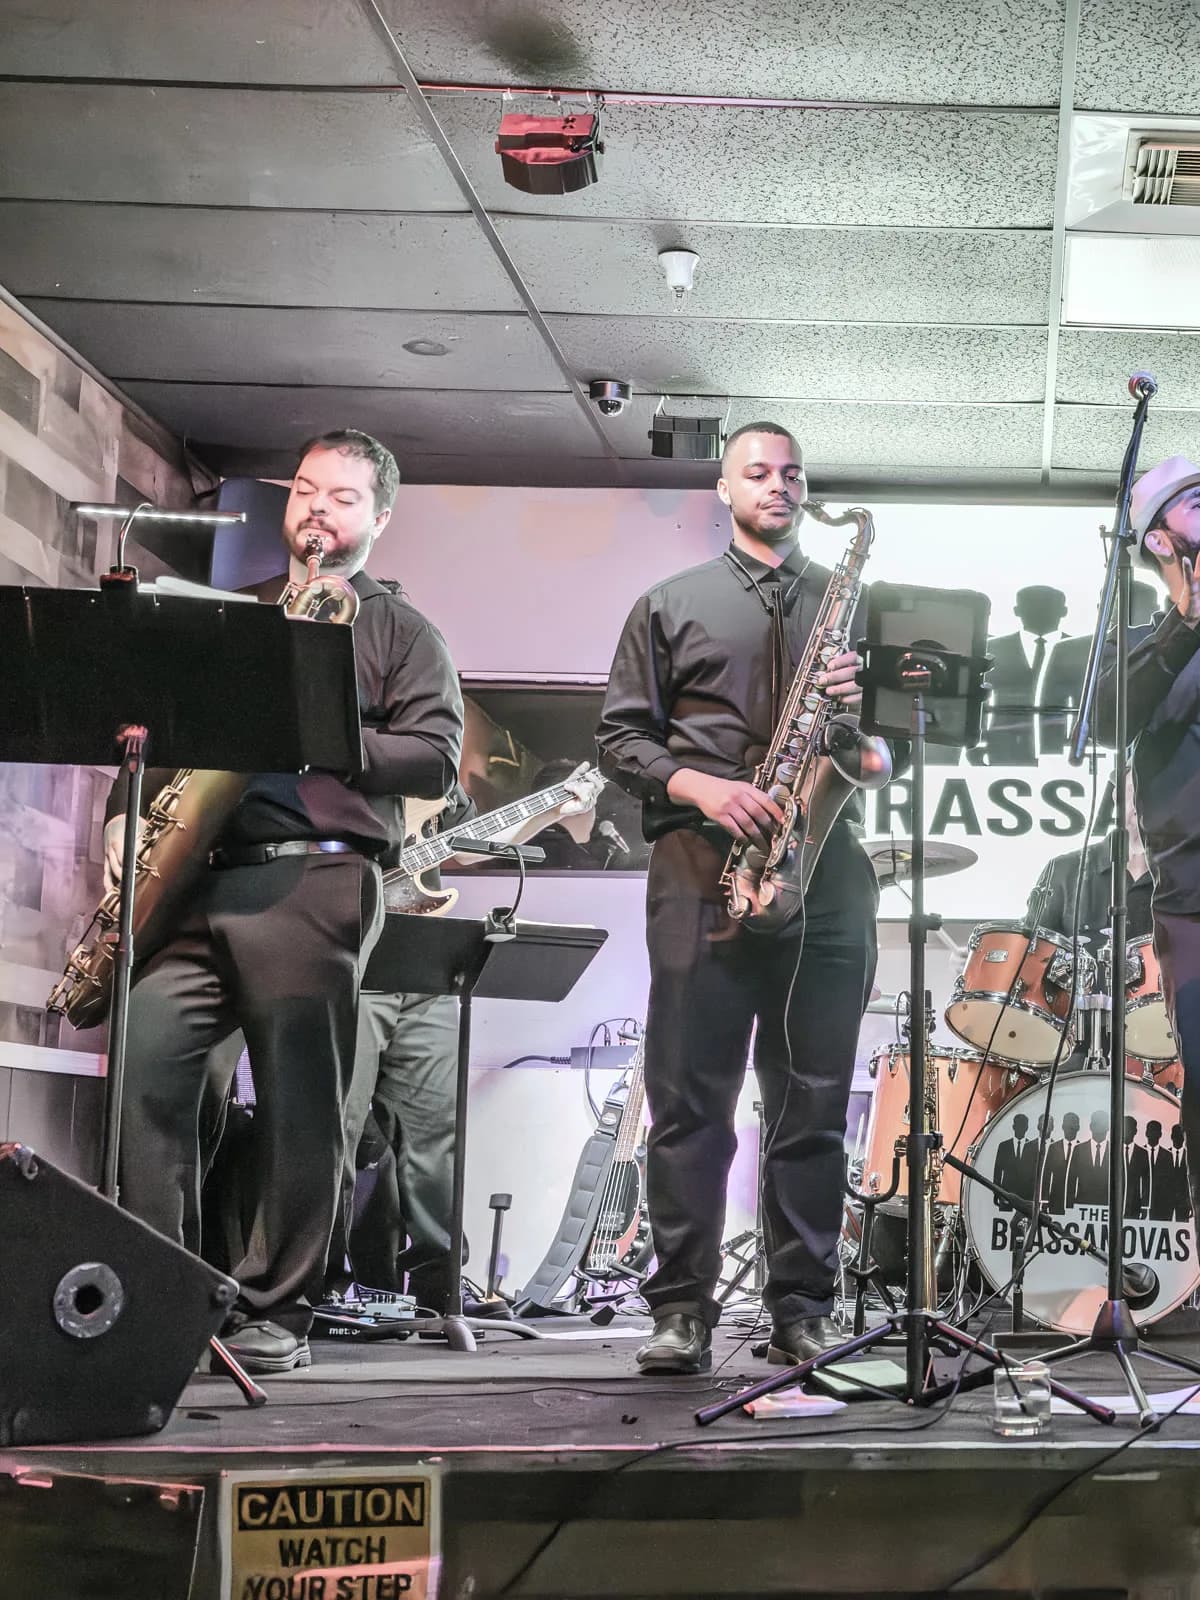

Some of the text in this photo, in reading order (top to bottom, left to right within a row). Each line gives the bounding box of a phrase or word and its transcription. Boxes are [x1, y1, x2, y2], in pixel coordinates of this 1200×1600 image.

[241, 1488, 422, 1526] CAUTION
[279, 1535, 386, 1568] WATCH
[243, 1573, 412, 1600] YOUR STEP
